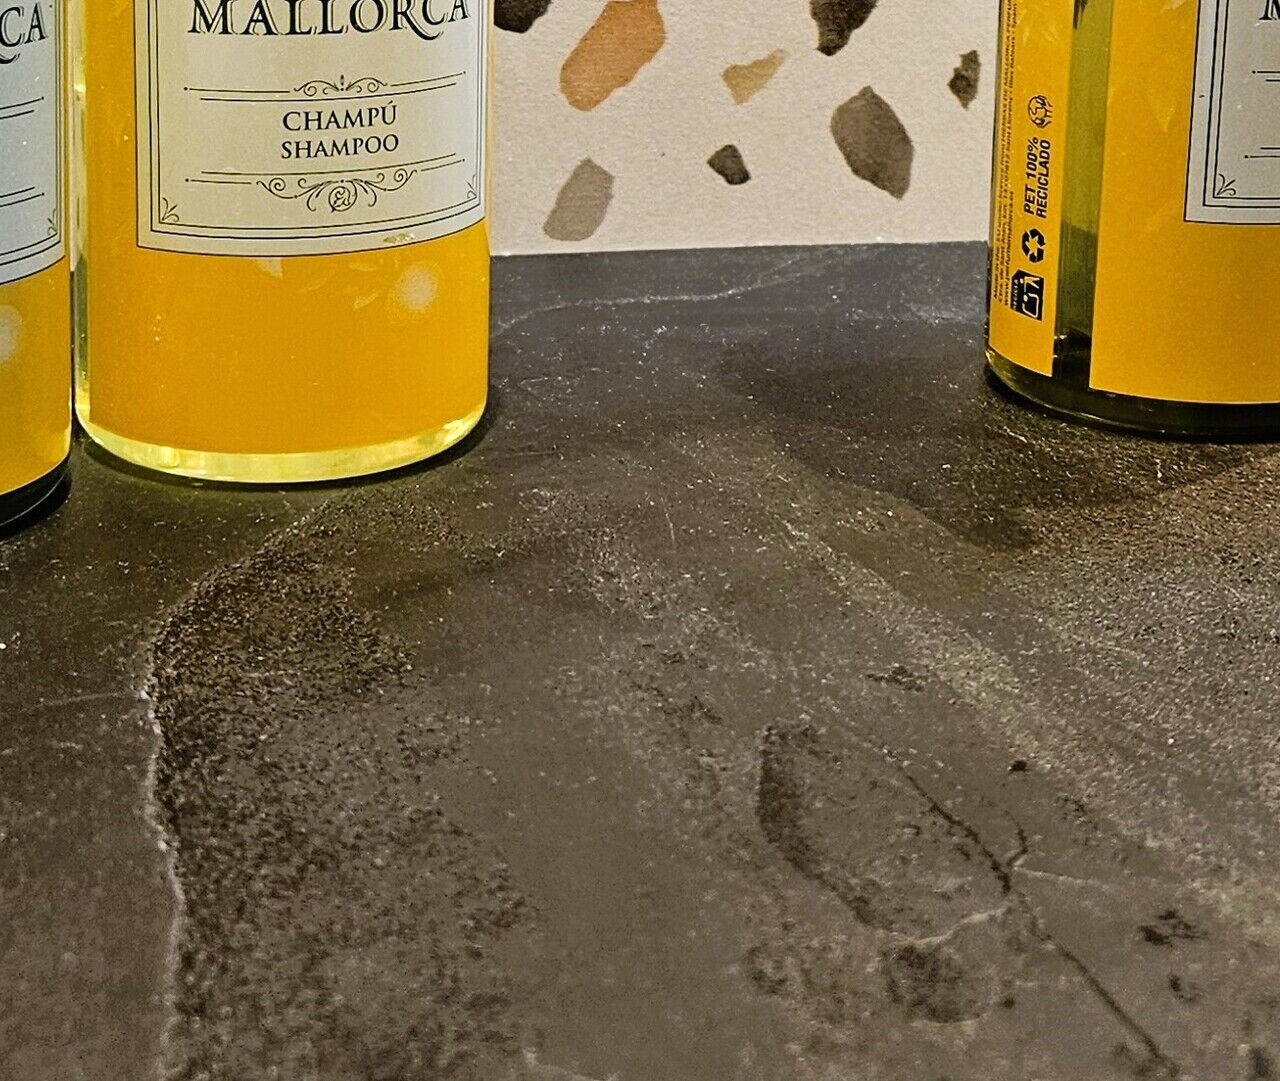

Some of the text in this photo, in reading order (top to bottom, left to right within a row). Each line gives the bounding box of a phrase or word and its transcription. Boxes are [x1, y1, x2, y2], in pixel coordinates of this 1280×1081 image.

[282, 101, 398, 132] CHAMPÚ
[280, 134, 400, 160] SHAMPOO
[1024, 137, 1038, 215] PET 100%
[1036, 139, 1051, 219] RECICLADO
